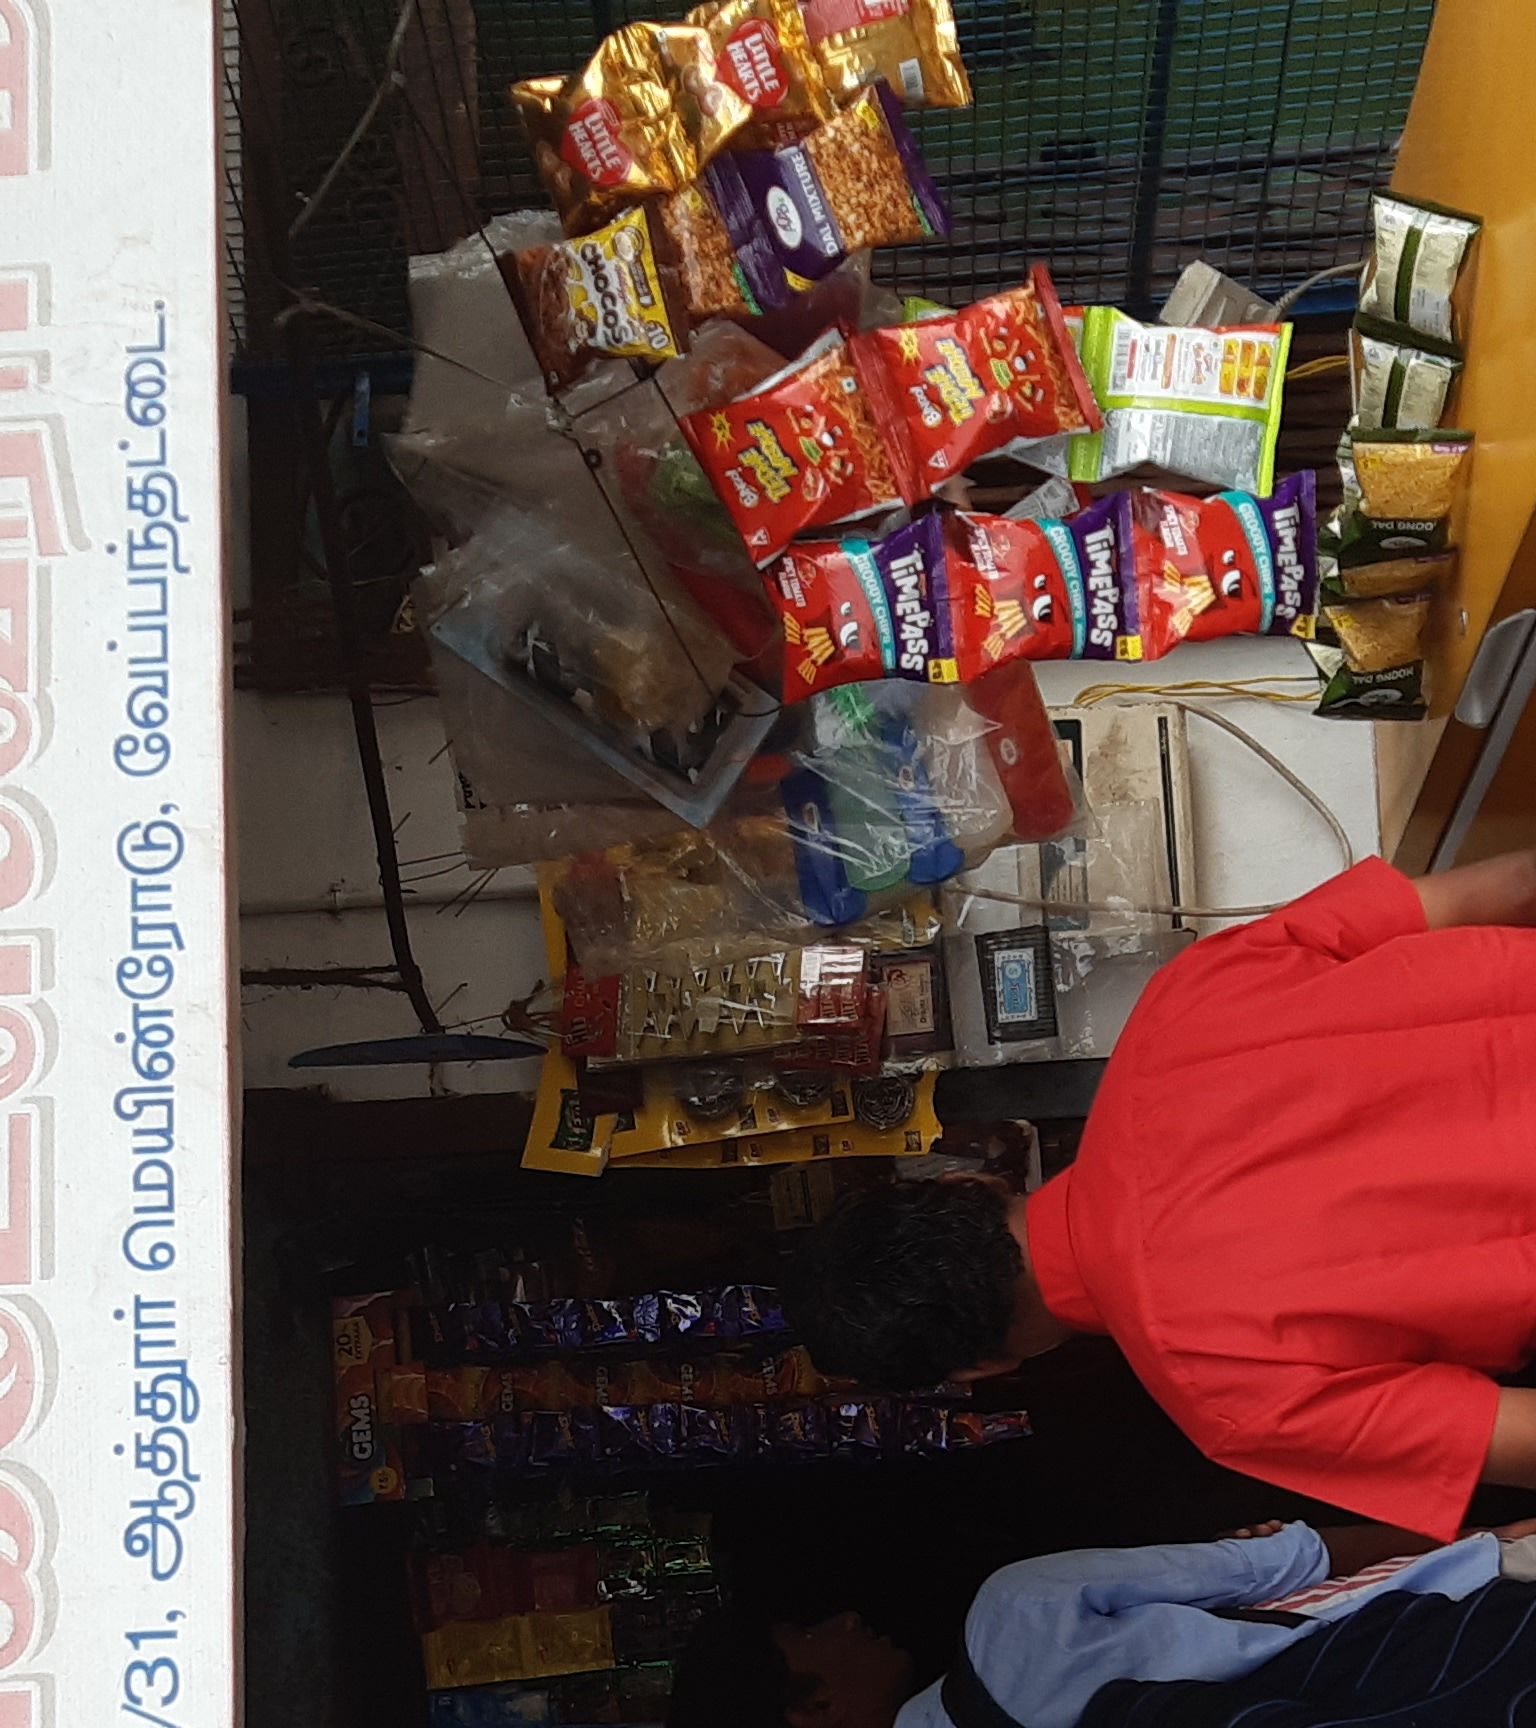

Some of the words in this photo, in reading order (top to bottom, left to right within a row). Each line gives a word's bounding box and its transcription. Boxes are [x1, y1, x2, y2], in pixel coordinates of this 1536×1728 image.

[726, 41, 761, 102] HEARTS
[744, 33, 781, 92] LITTLE
[568, 121, 602, 181] HEARTS
[584, 112, 621, 168] LITTLE
[793, 151, 825, 221] MIXTURE
[819, 222, 840, 255] DAL
[580, 243, 628, 345] CHOCOS
[105, 299, 190, 779] வேப்பந்தட்டை.
[1394, 519, 1436, 531] OONG
[1069, 580, 1084, 619] CHIPS
[1258, 555, 1272, 594] CHIPS
[874, 606, 892, 645] CHIPS
[500, 1372, 514, 1412] GEMS
[114, 1294, 200, 1581] ஆத்தூர்
[349, 1394, 373, 1460] GEMS
